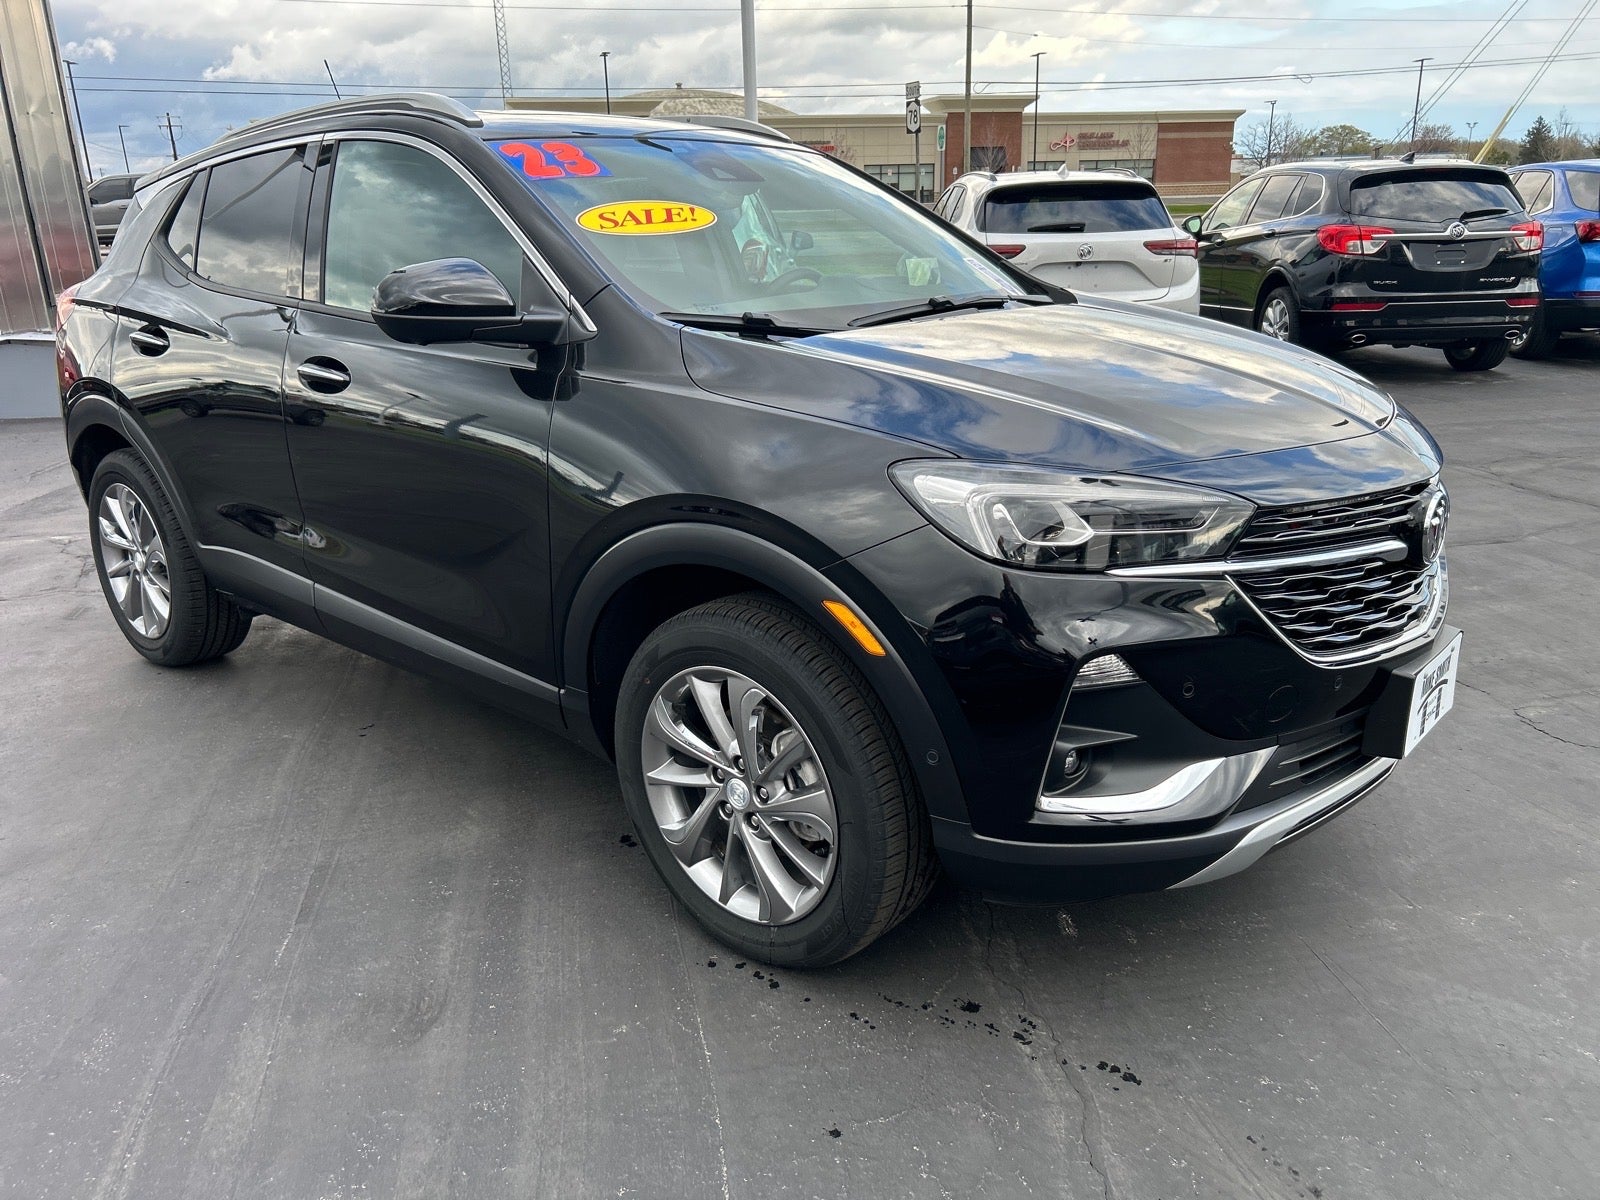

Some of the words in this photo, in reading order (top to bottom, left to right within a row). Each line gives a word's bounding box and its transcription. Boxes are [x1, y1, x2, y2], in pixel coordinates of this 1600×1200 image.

[908, 109, 919, 125] 78
[499, 141, 600, 178] 23
[598, 207, 698, 230] SALE!
